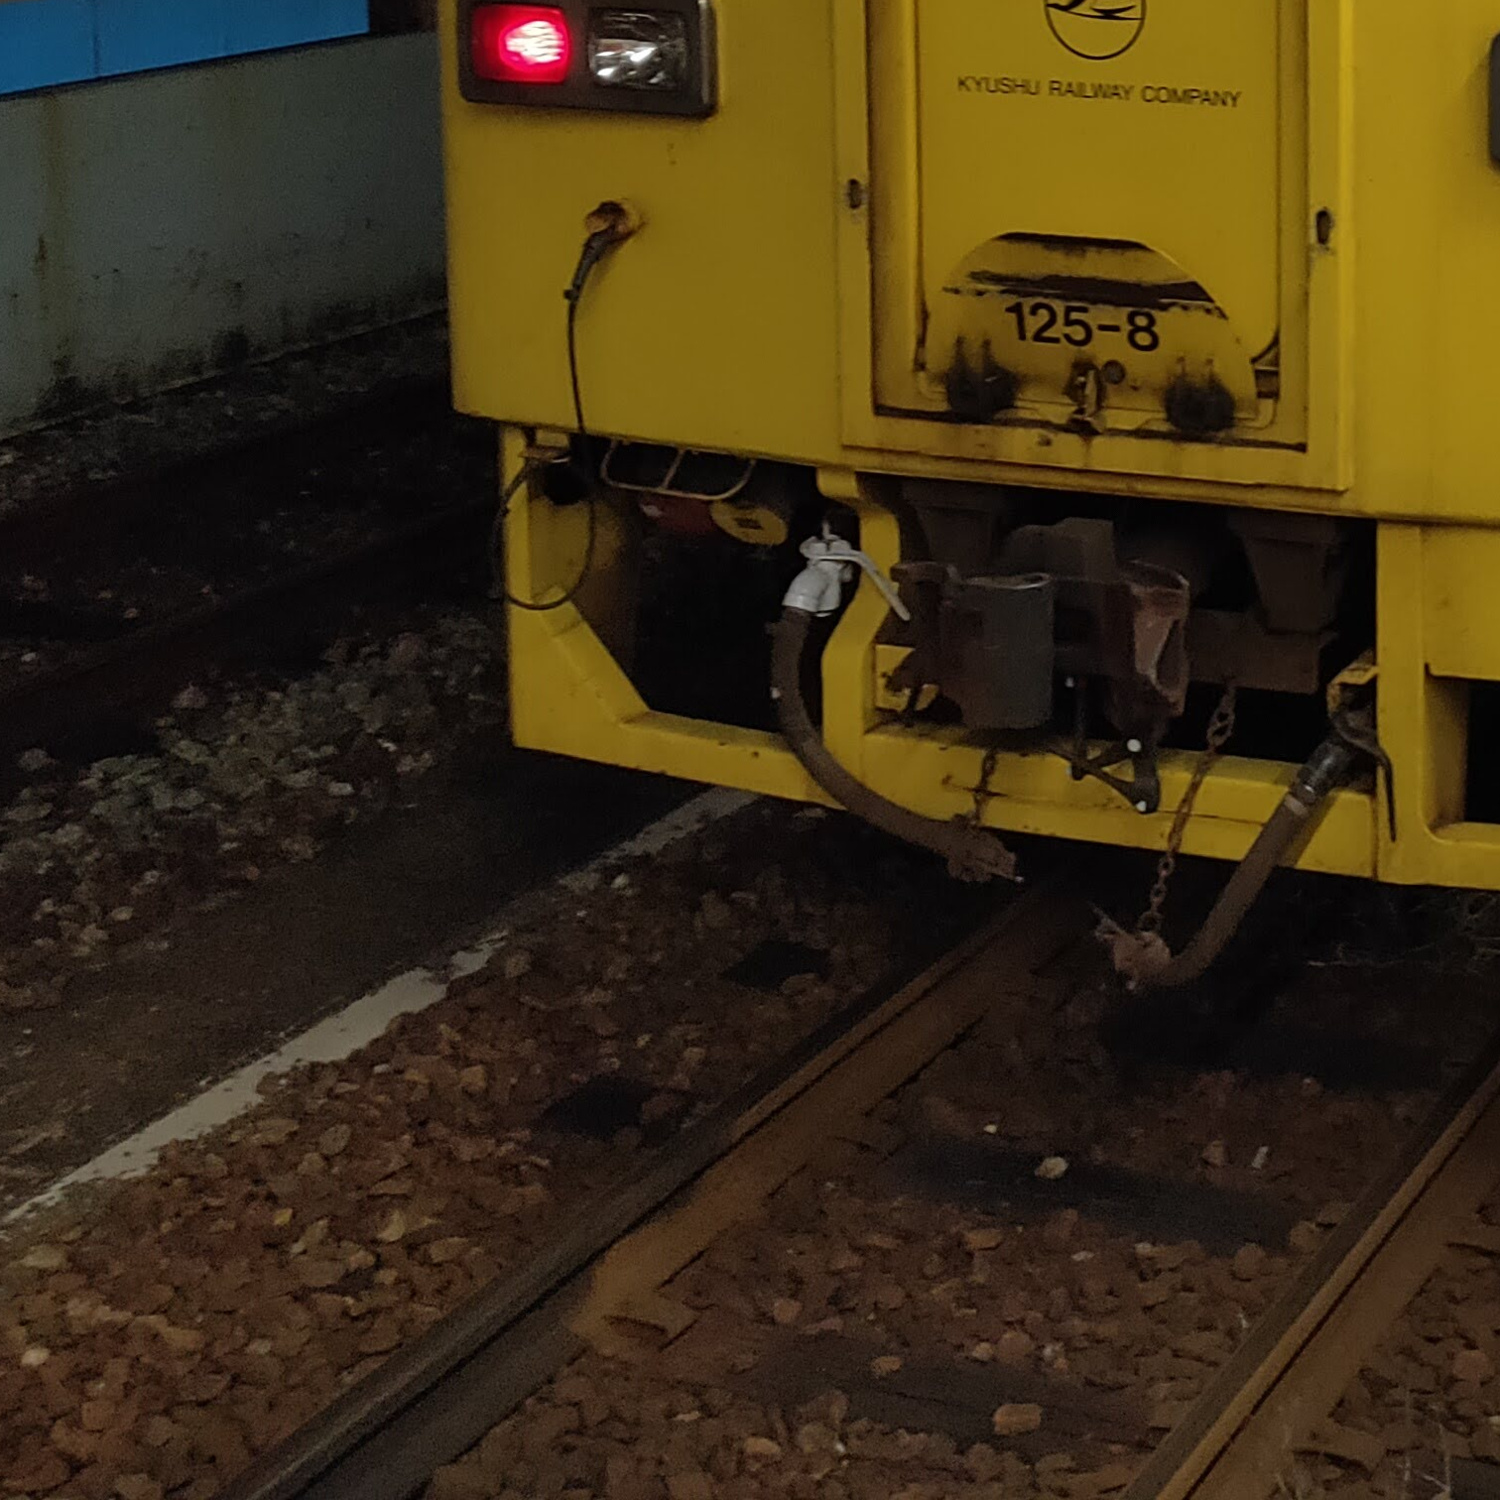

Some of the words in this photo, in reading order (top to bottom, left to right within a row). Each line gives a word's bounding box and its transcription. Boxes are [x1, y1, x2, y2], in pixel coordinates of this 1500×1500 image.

[957, 76, 1041, 96] KYUSHU
[1049, 80, 1135, 100] RAILWAY
[1141, 85, 1243, 108] COMPANY
[1005, 301, 1160, 352] 125-8
